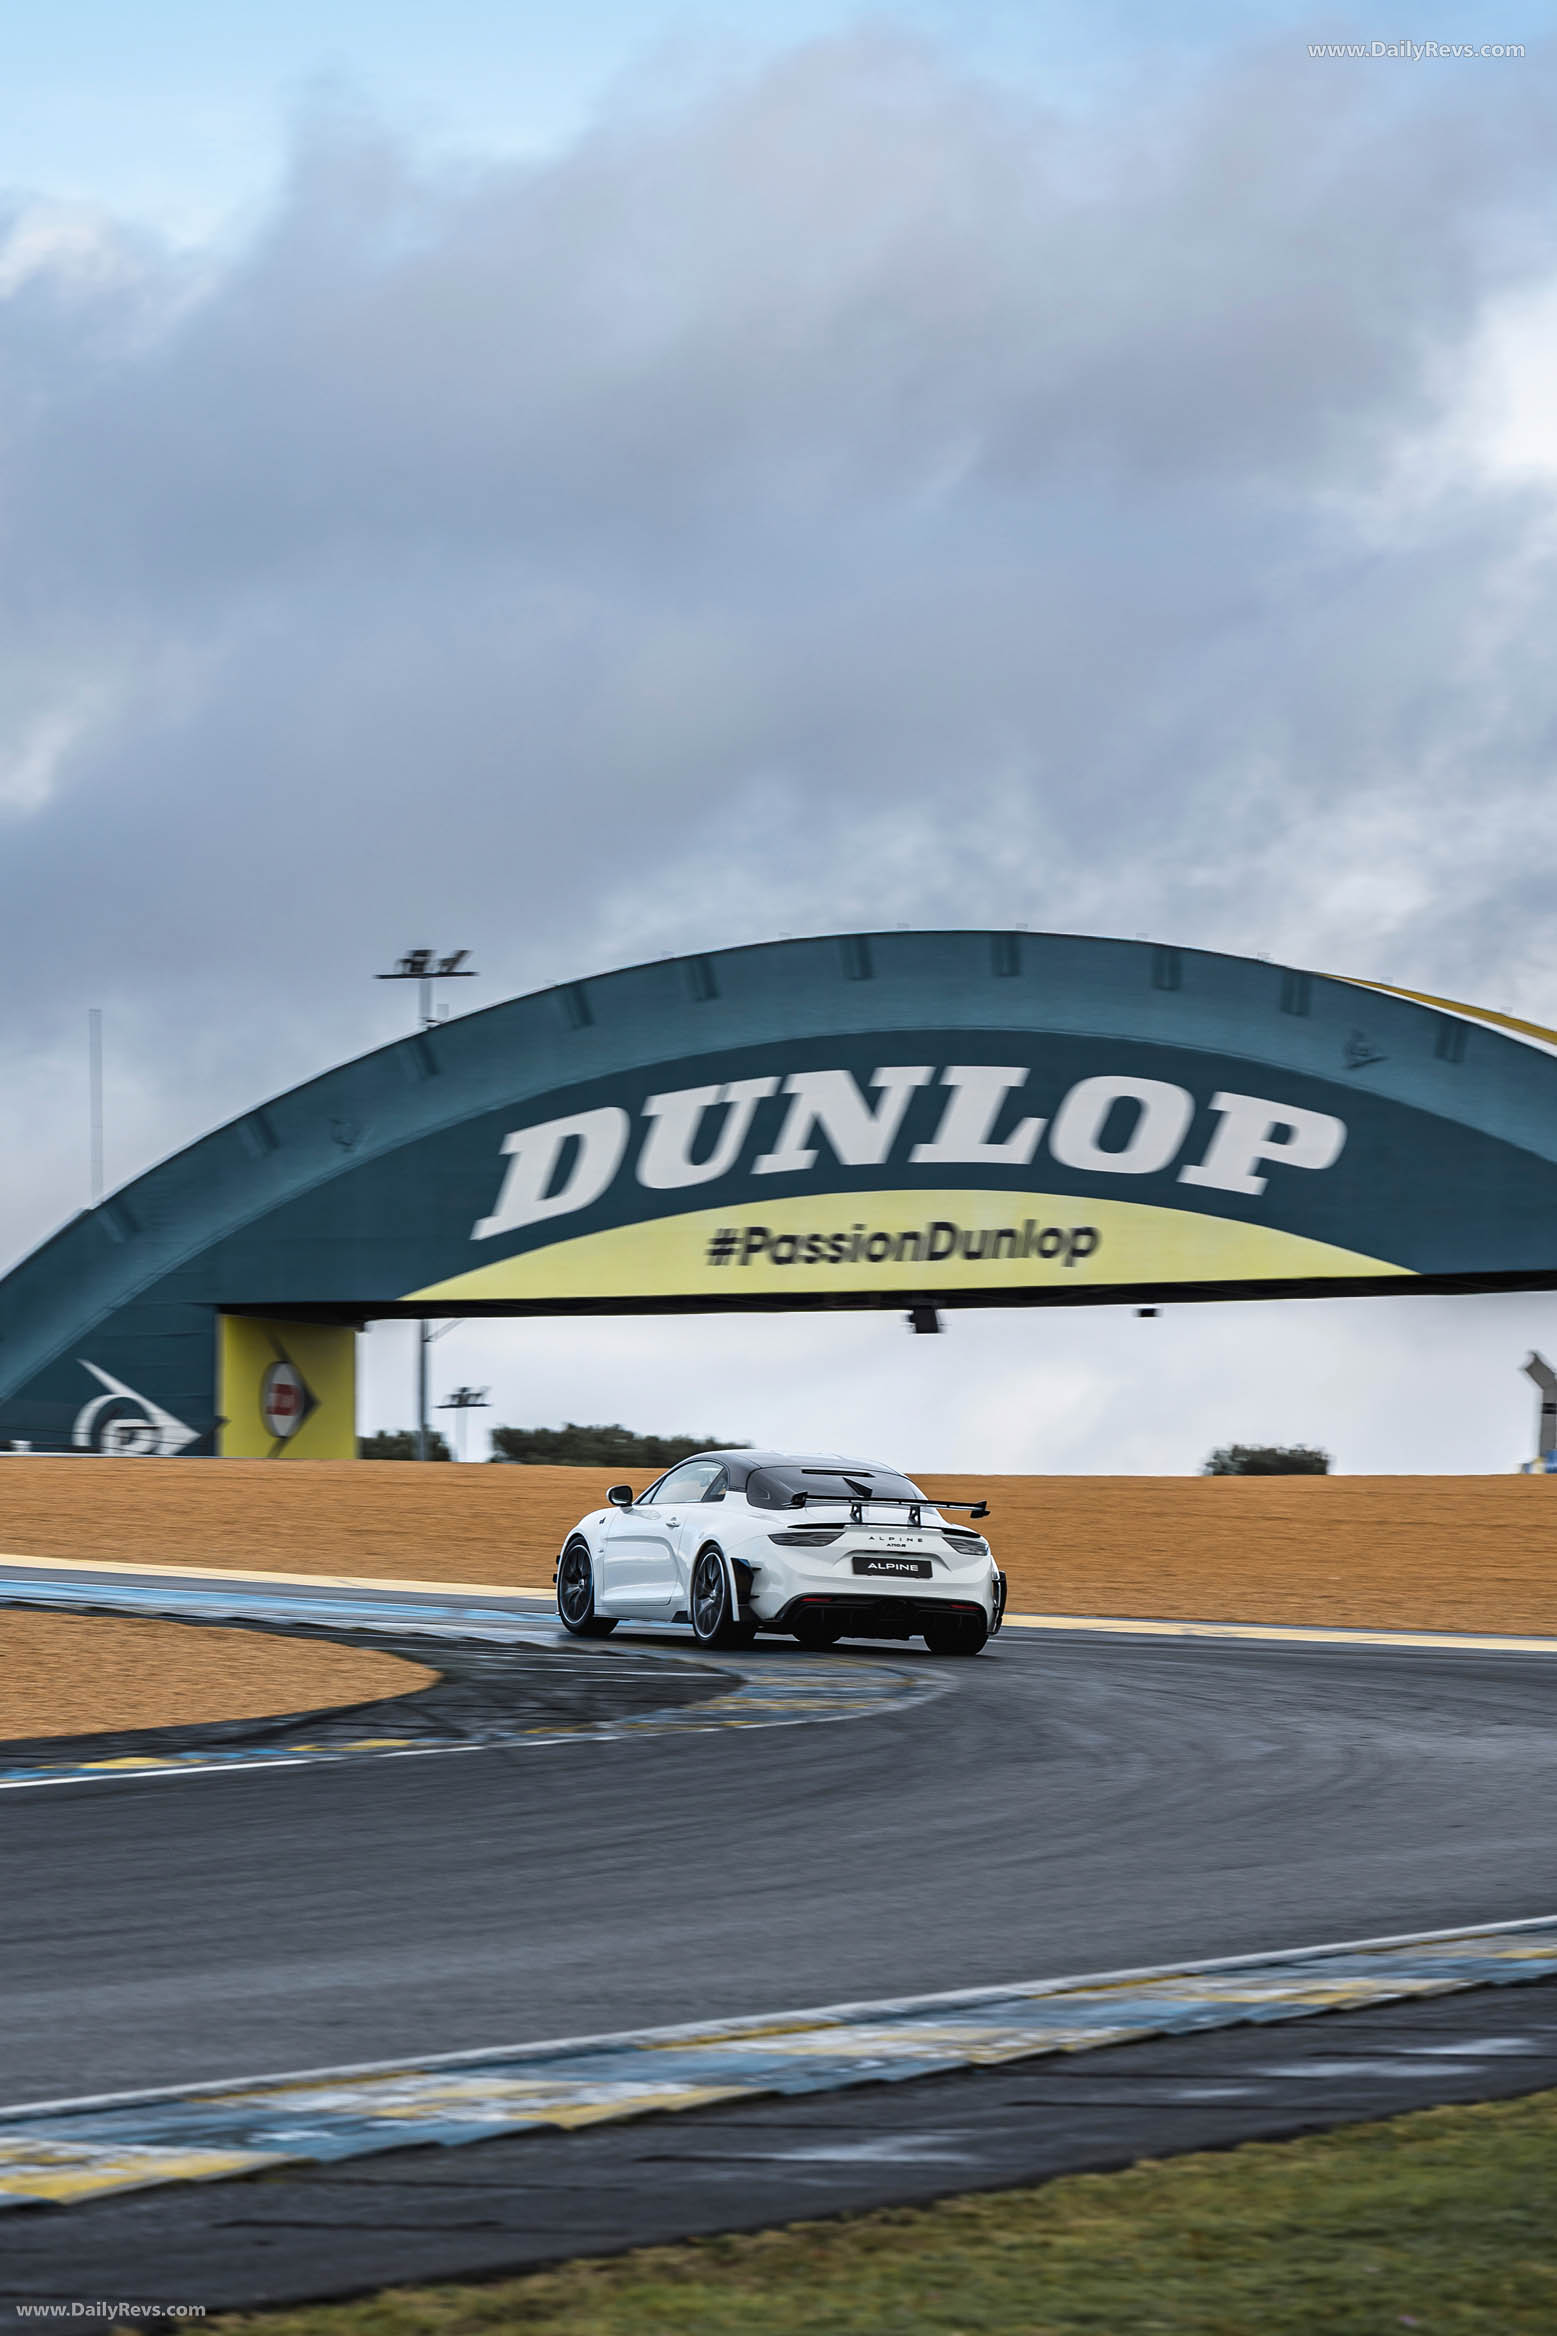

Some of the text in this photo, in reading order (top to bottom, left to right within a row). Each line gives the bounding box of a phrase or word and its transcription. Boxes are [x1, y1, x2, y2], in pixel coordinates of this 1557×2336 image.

[471, 1066, 1347, 1240] DUNLOP
[706, 1219, 1100, 1267] #PassionDunlop
[867, 1562, 919, 1571] ALPINE
